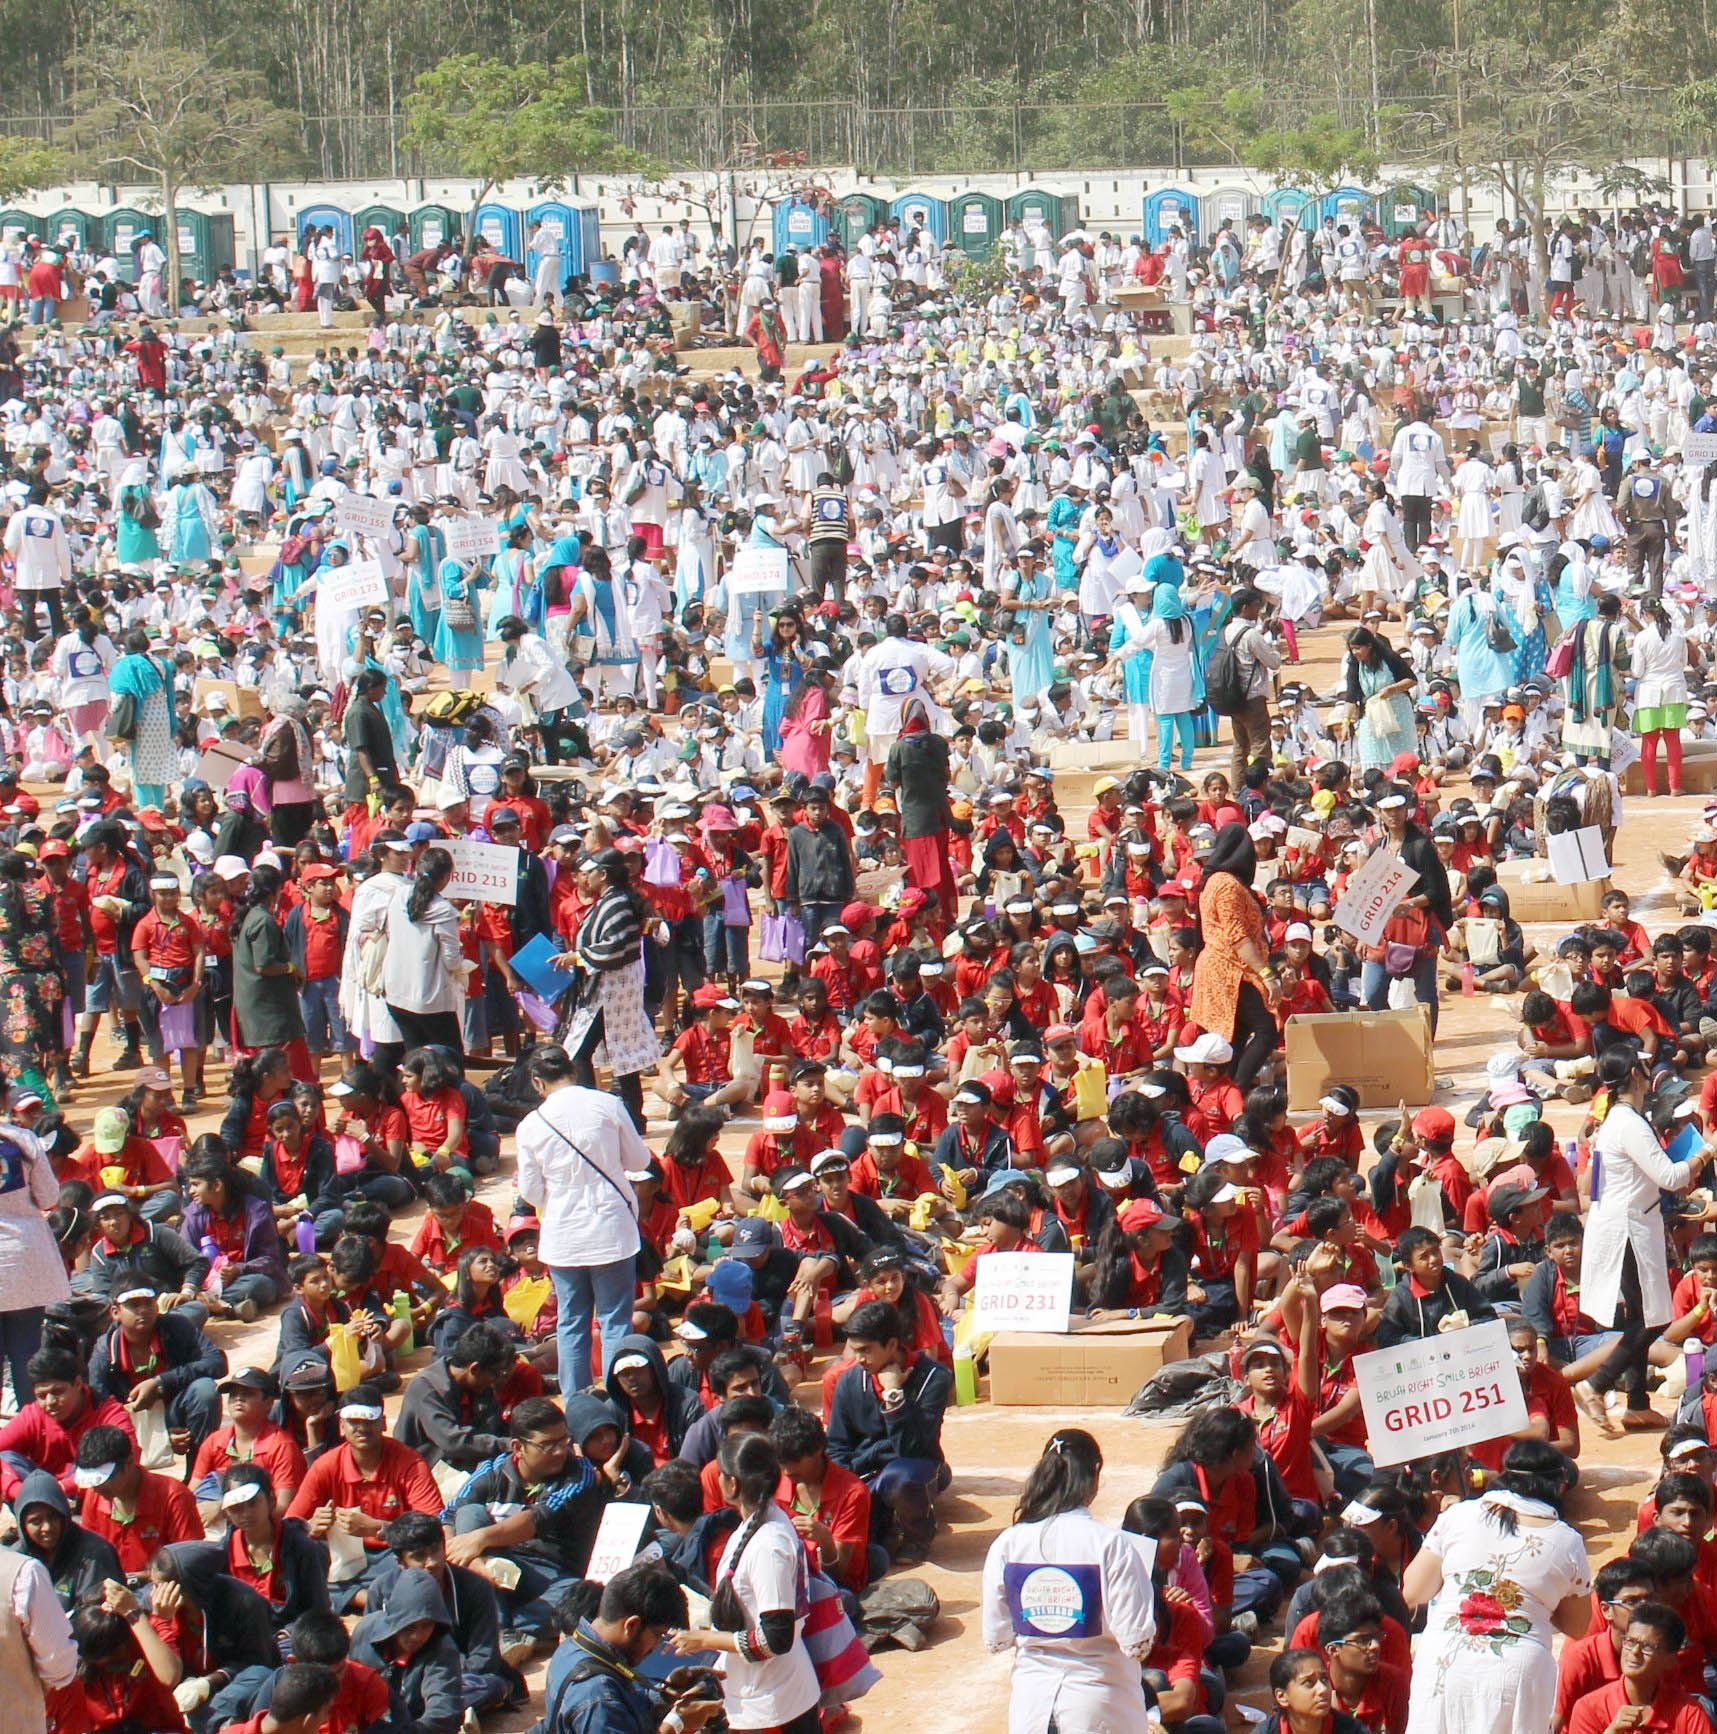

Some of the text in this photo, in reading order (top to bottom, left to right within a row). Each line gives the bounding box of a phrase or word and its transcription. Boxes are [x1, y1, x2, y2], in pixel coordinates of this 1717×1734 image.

[344, 512, 386, 528] GRID 155
[452, 537, 477, 549] GRID
[334, 583, 379, 602] GRID 173
[482, 874, 507, 888] 213
[1359, 896, 1384, 931] GRID
[1380, 871, 1403, 895] 214
[980, 1294, 1057, 1311] GRID 231
[1376, 1386, 1406, 1403] BRUSH
[1408, 1377, 1435, 1394] RIGHT
[1468, 1360, 1501, 1380] BRIGHT
[1384, 1383, 1506, 1432] GRID 251
